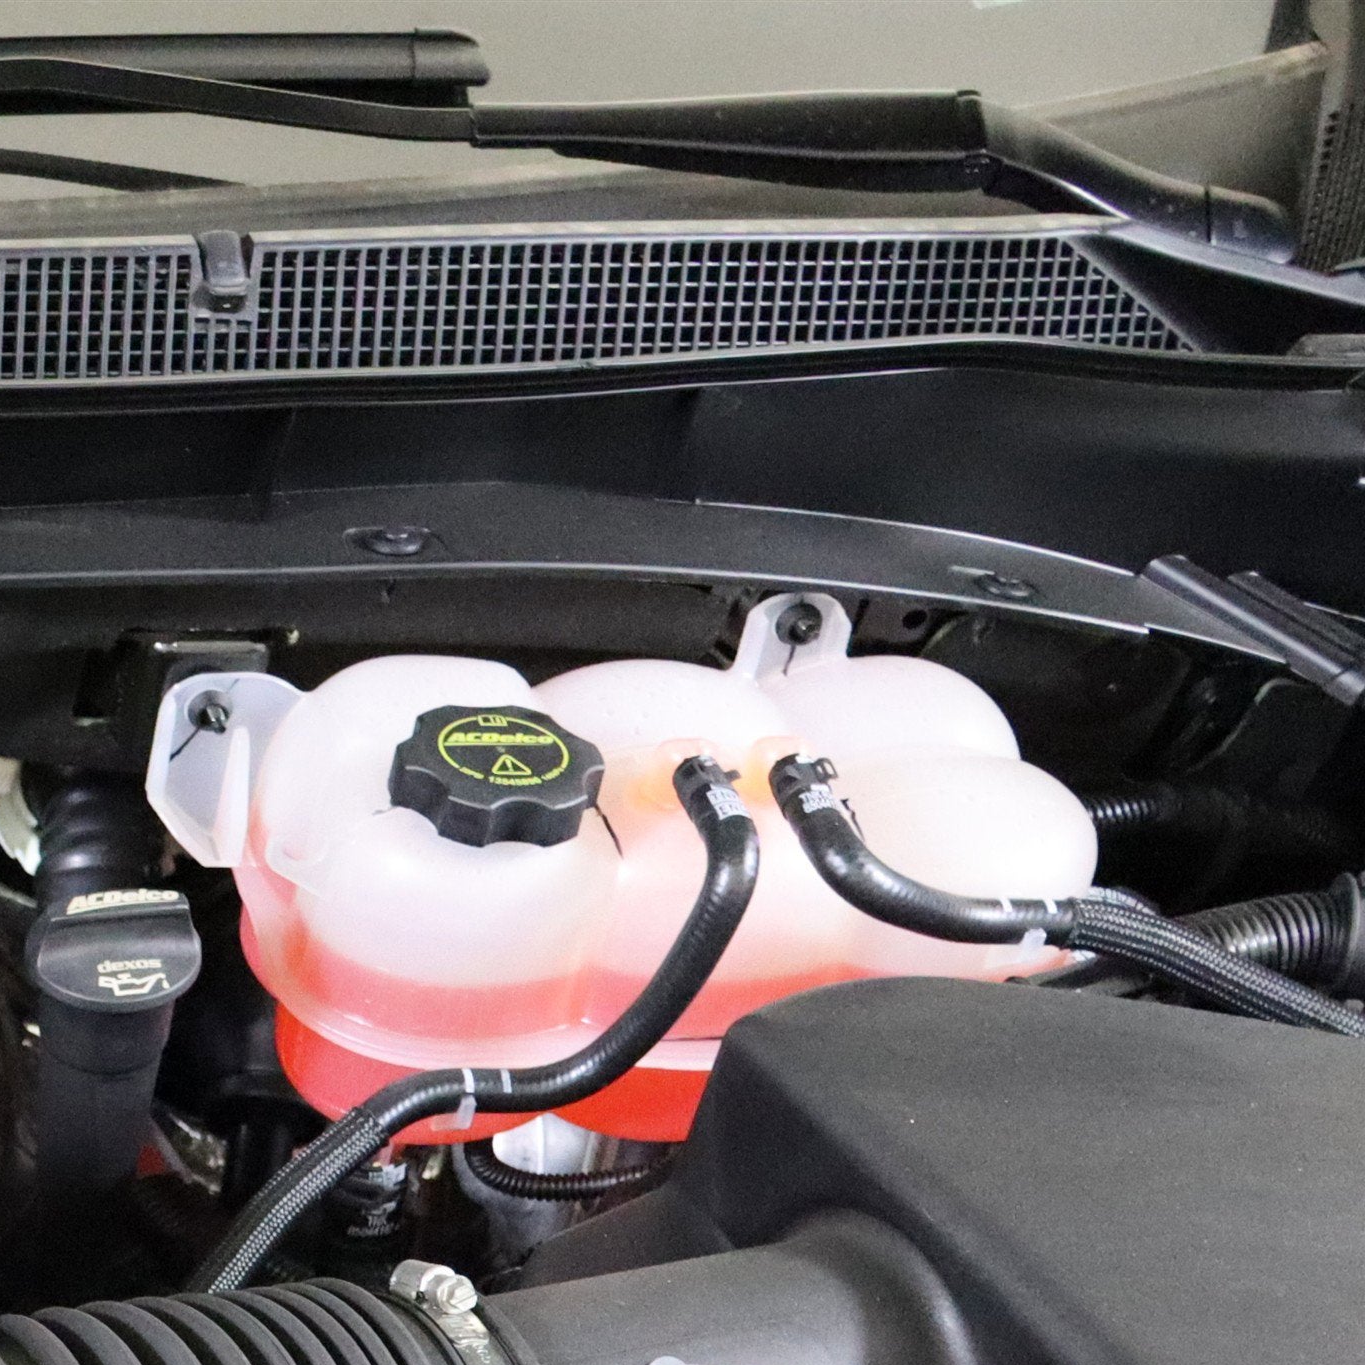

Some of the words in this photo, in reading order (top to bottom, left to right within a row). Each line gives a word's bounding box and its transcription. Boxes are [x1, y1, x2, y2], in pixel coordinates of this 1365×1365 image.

[446, 731, 555, 746] ACDelco
[66, 888, 180, 914] ACDelco
[97, 959, 162, 974] dexos
